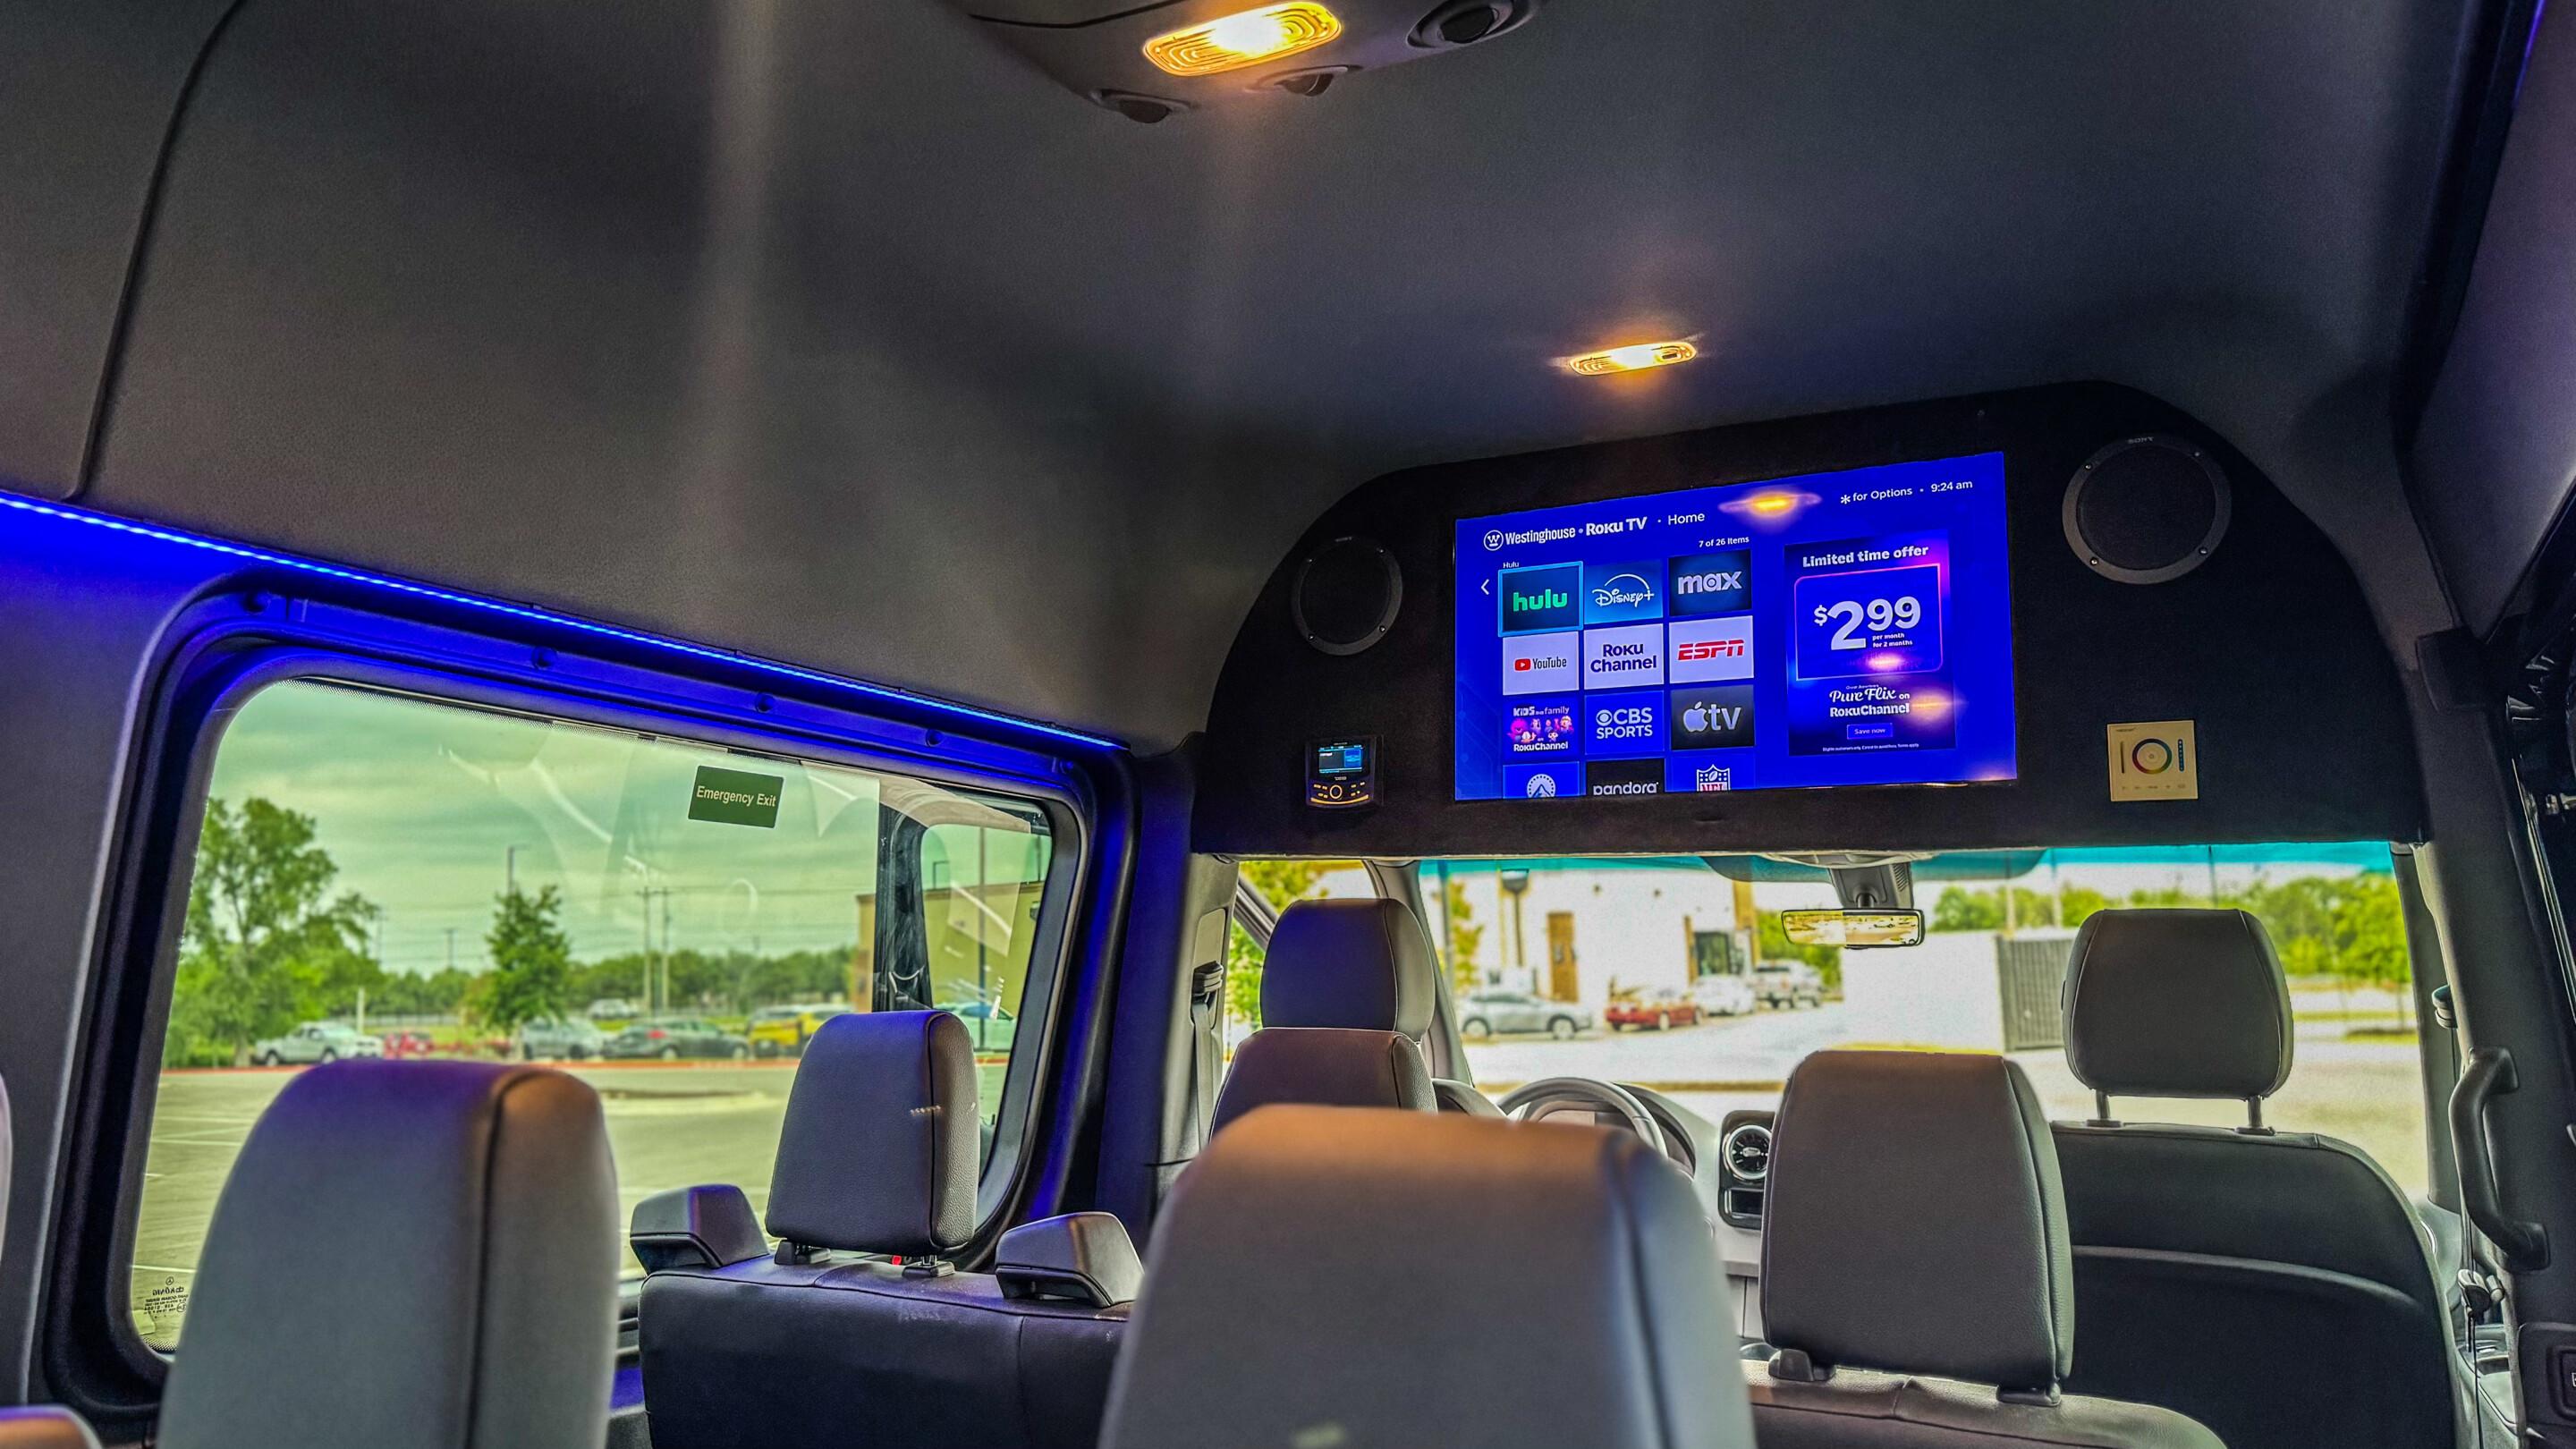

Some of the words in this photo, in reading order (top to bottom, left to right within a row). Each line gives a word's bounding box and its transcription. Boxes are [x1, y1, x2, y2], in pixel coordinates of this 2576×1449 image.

[1852, 491, 1868, 502] for
[1870, 487, 1912, 500] Options
[1930, 482, 1953, 493] 9:24
[1955, 481, 1973, 490] am
[1504, 526, 1576, 545] Westinghouse
[1586, 521, 1623, 536] Roku
[1625, 516, 1648, 530] TV
[1667, 513, 1705, 526] Home
[1705, 538, 1714, 547] of
[1716, 538, 1725, 547] 26
[1503, 561, 1520, 569] Hulu
[1802, 552, 1854, 568] Limited
[1857, 549, 1890, 563] time
[1893, 545, 1928, 558] offer
[1677, 571, 1742, 595] max
[1513, 589, 1568, 612] hulu
[1602, 643, 1644, 657] Roku
[1677, 639, 1744, 661] ESPN
[1532, 657, 1567, 670] YouTube
[1590, 655, 1657, 673] Channel
[1899, 692, 1911, 700] on
[1544, 705, 1570, 716] family
[1614, 707, 1653, 724] CBS
[1710, 703, 1741, 731] tv
[1596, 724, 1653, 740] SPORTS
[696, 785, 754, 807] Emergency
[757, 793, 776, 807] Exit
[1593, 781, 1655, 795] pandora
